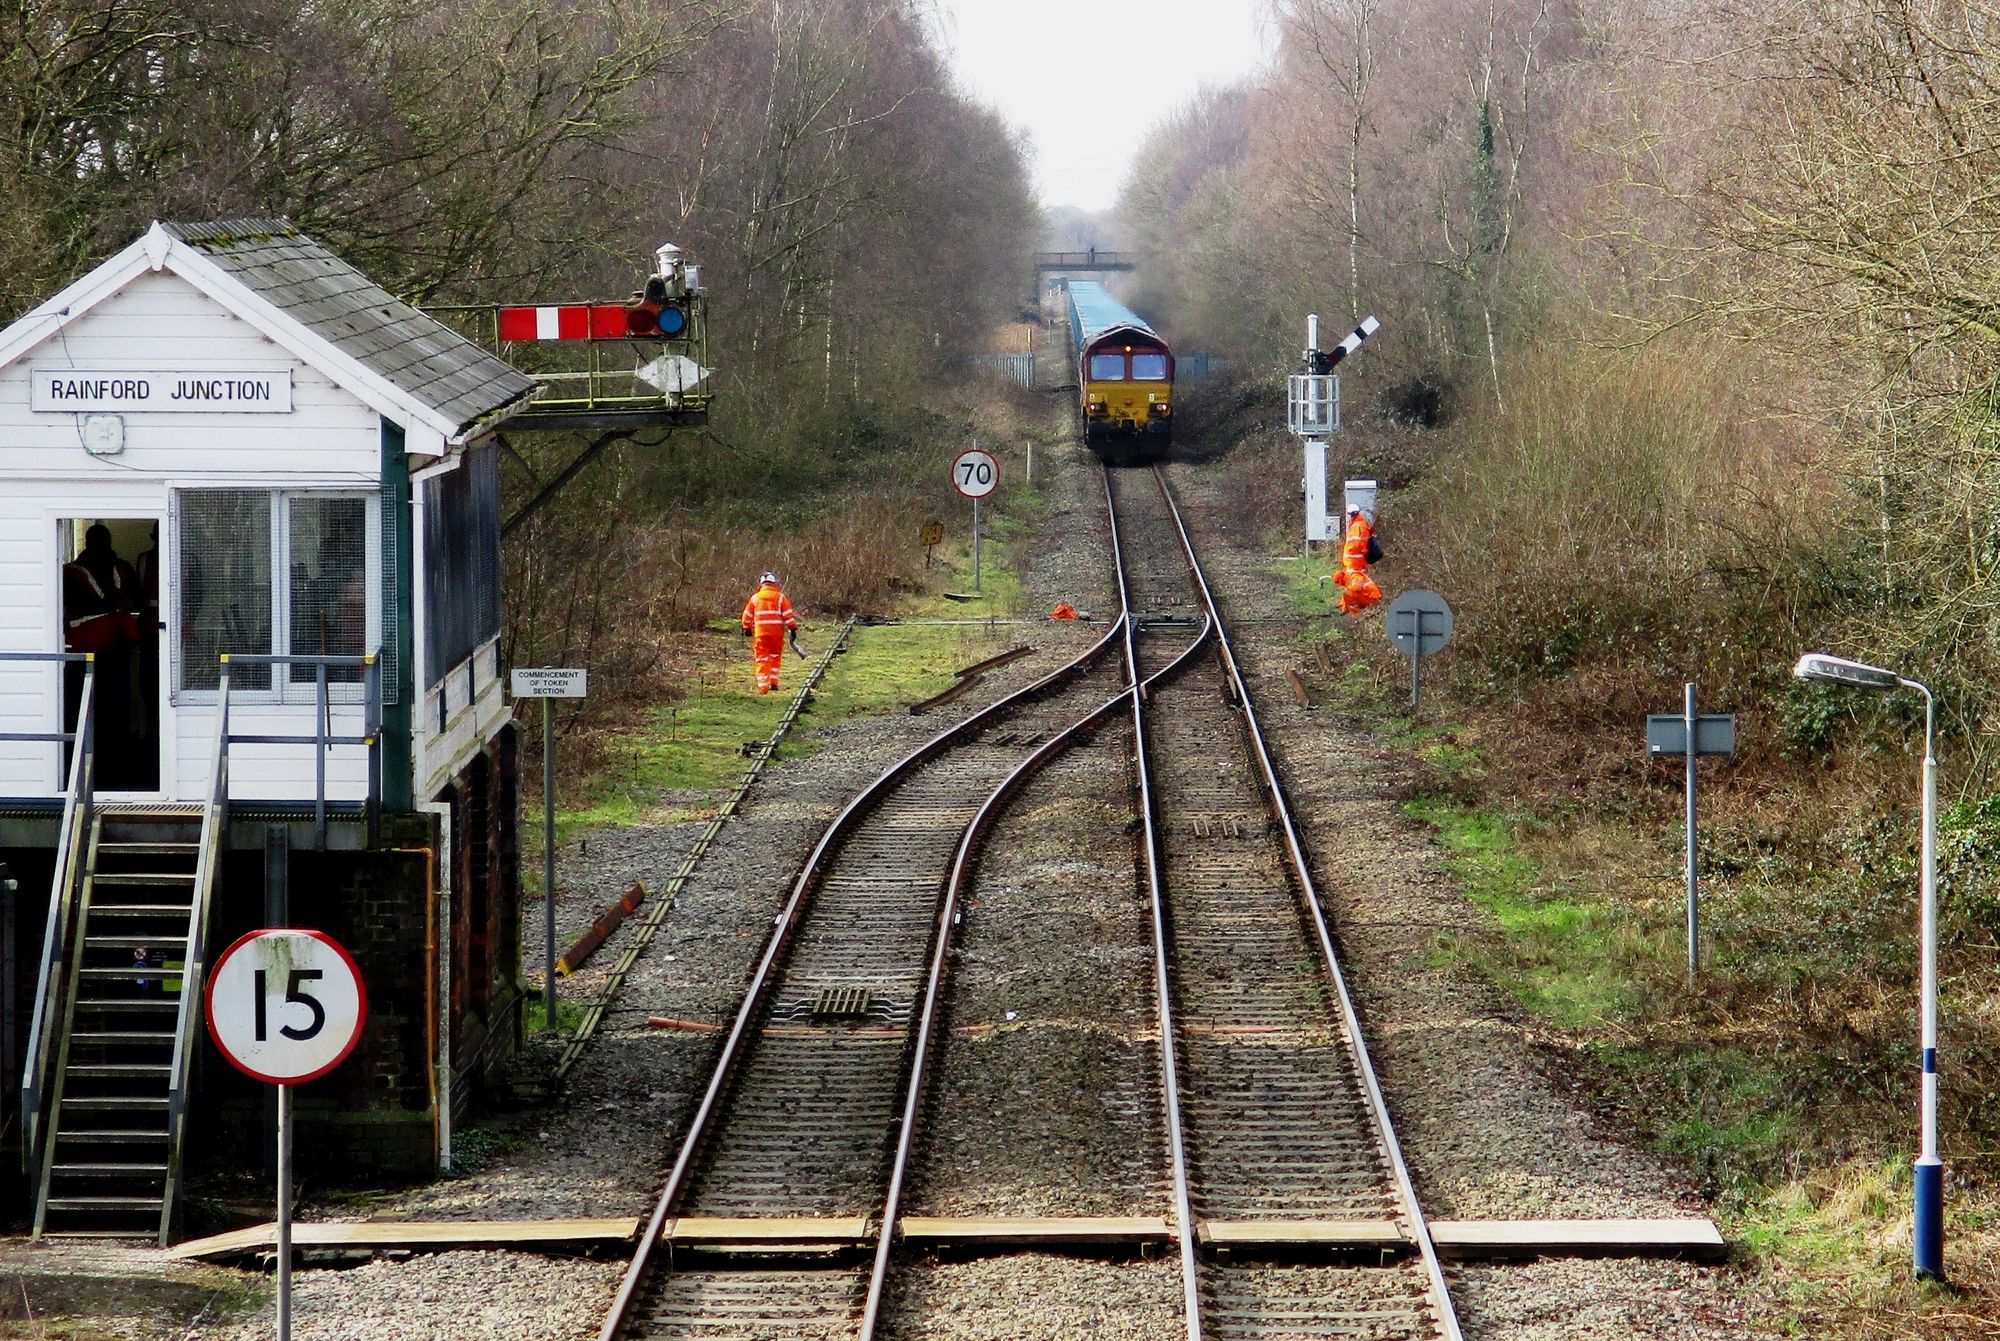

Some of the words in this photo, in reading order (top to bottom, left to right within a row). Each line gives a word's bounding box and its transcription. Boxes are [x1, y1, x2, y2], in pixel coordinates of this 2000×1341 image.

[51, 380, 150, 400] RAINFORD
[171, 380, 270, 400] JUNCTION
[960, 463, 991, 485] 70
[254, 969, 326, 1042] 15
